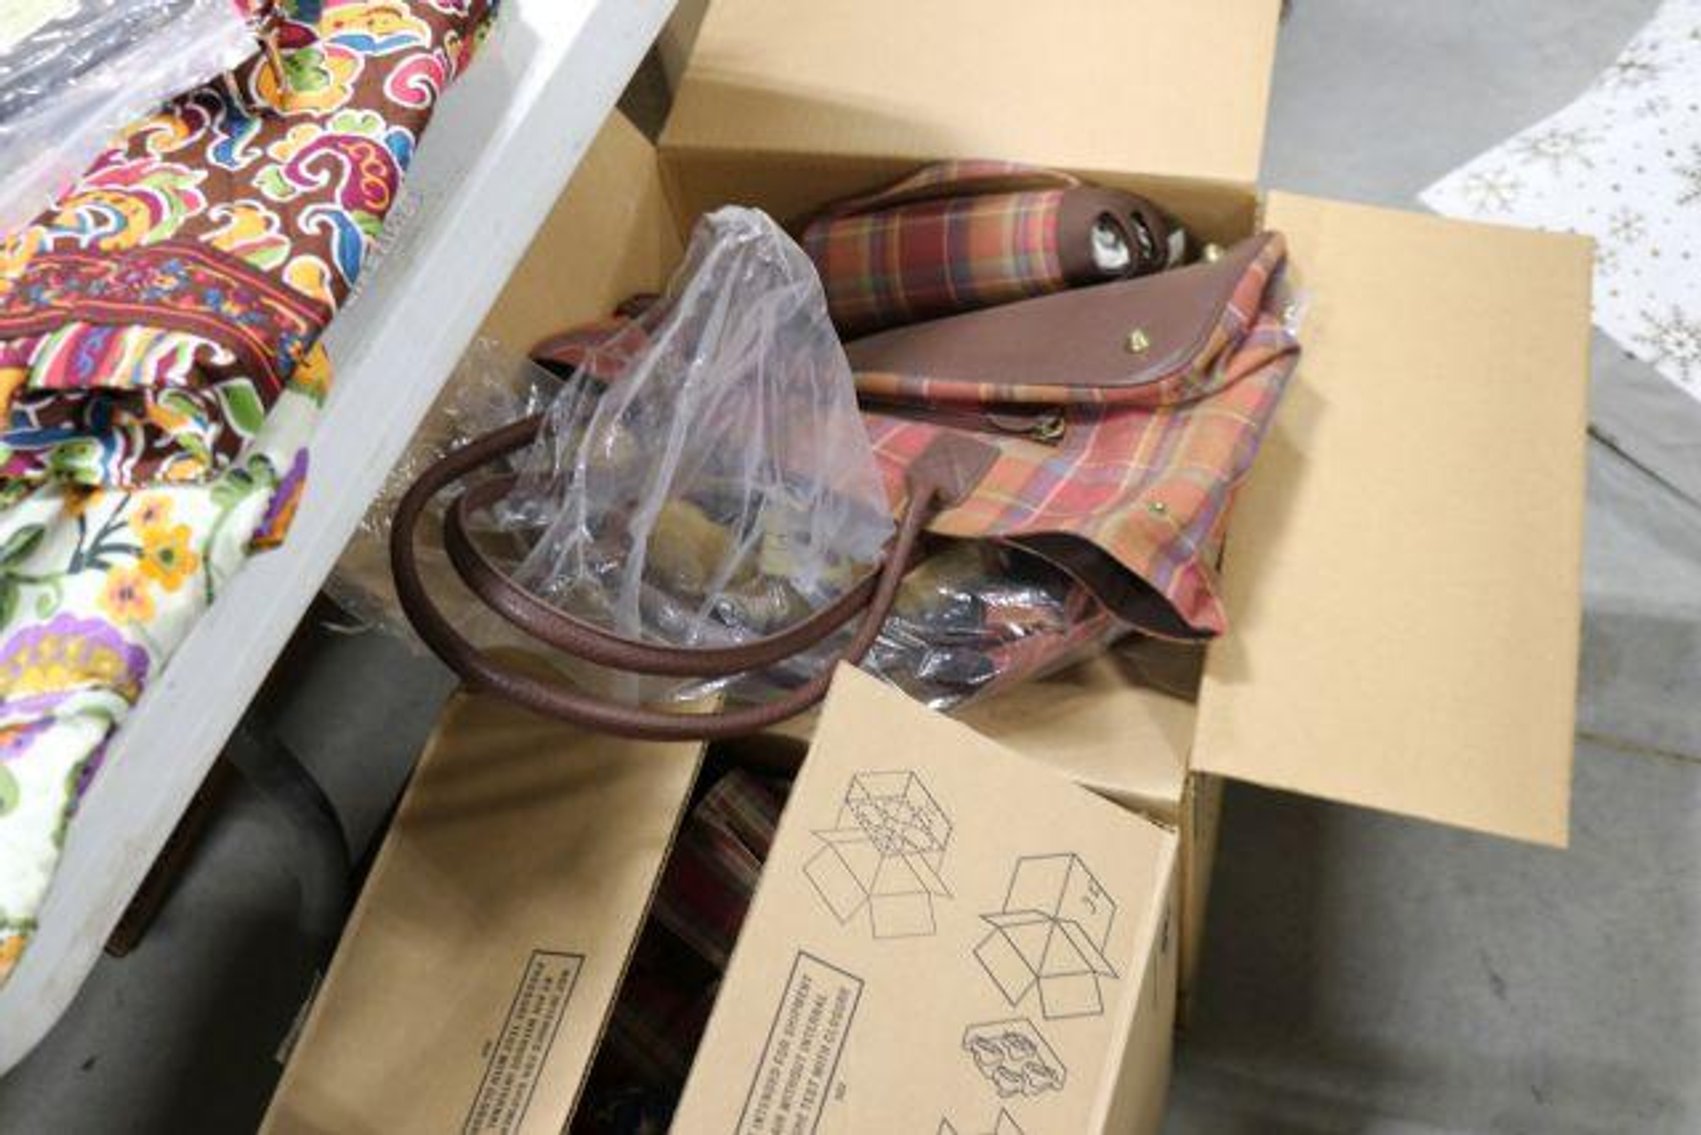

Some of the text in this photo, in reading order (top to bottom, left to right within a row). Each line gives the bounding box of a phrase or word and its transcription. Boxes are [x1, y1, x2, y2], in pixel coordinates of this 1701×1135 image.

[774, 1039, 790, 1065] FOR
[784, 974, 812, 1037] SHIPMENT
[781, 1054, 806, 1112] WITHOUT
[801, 995, 828, 1052] INTERNAL
[801, 1079, 820, 1110] TEST
